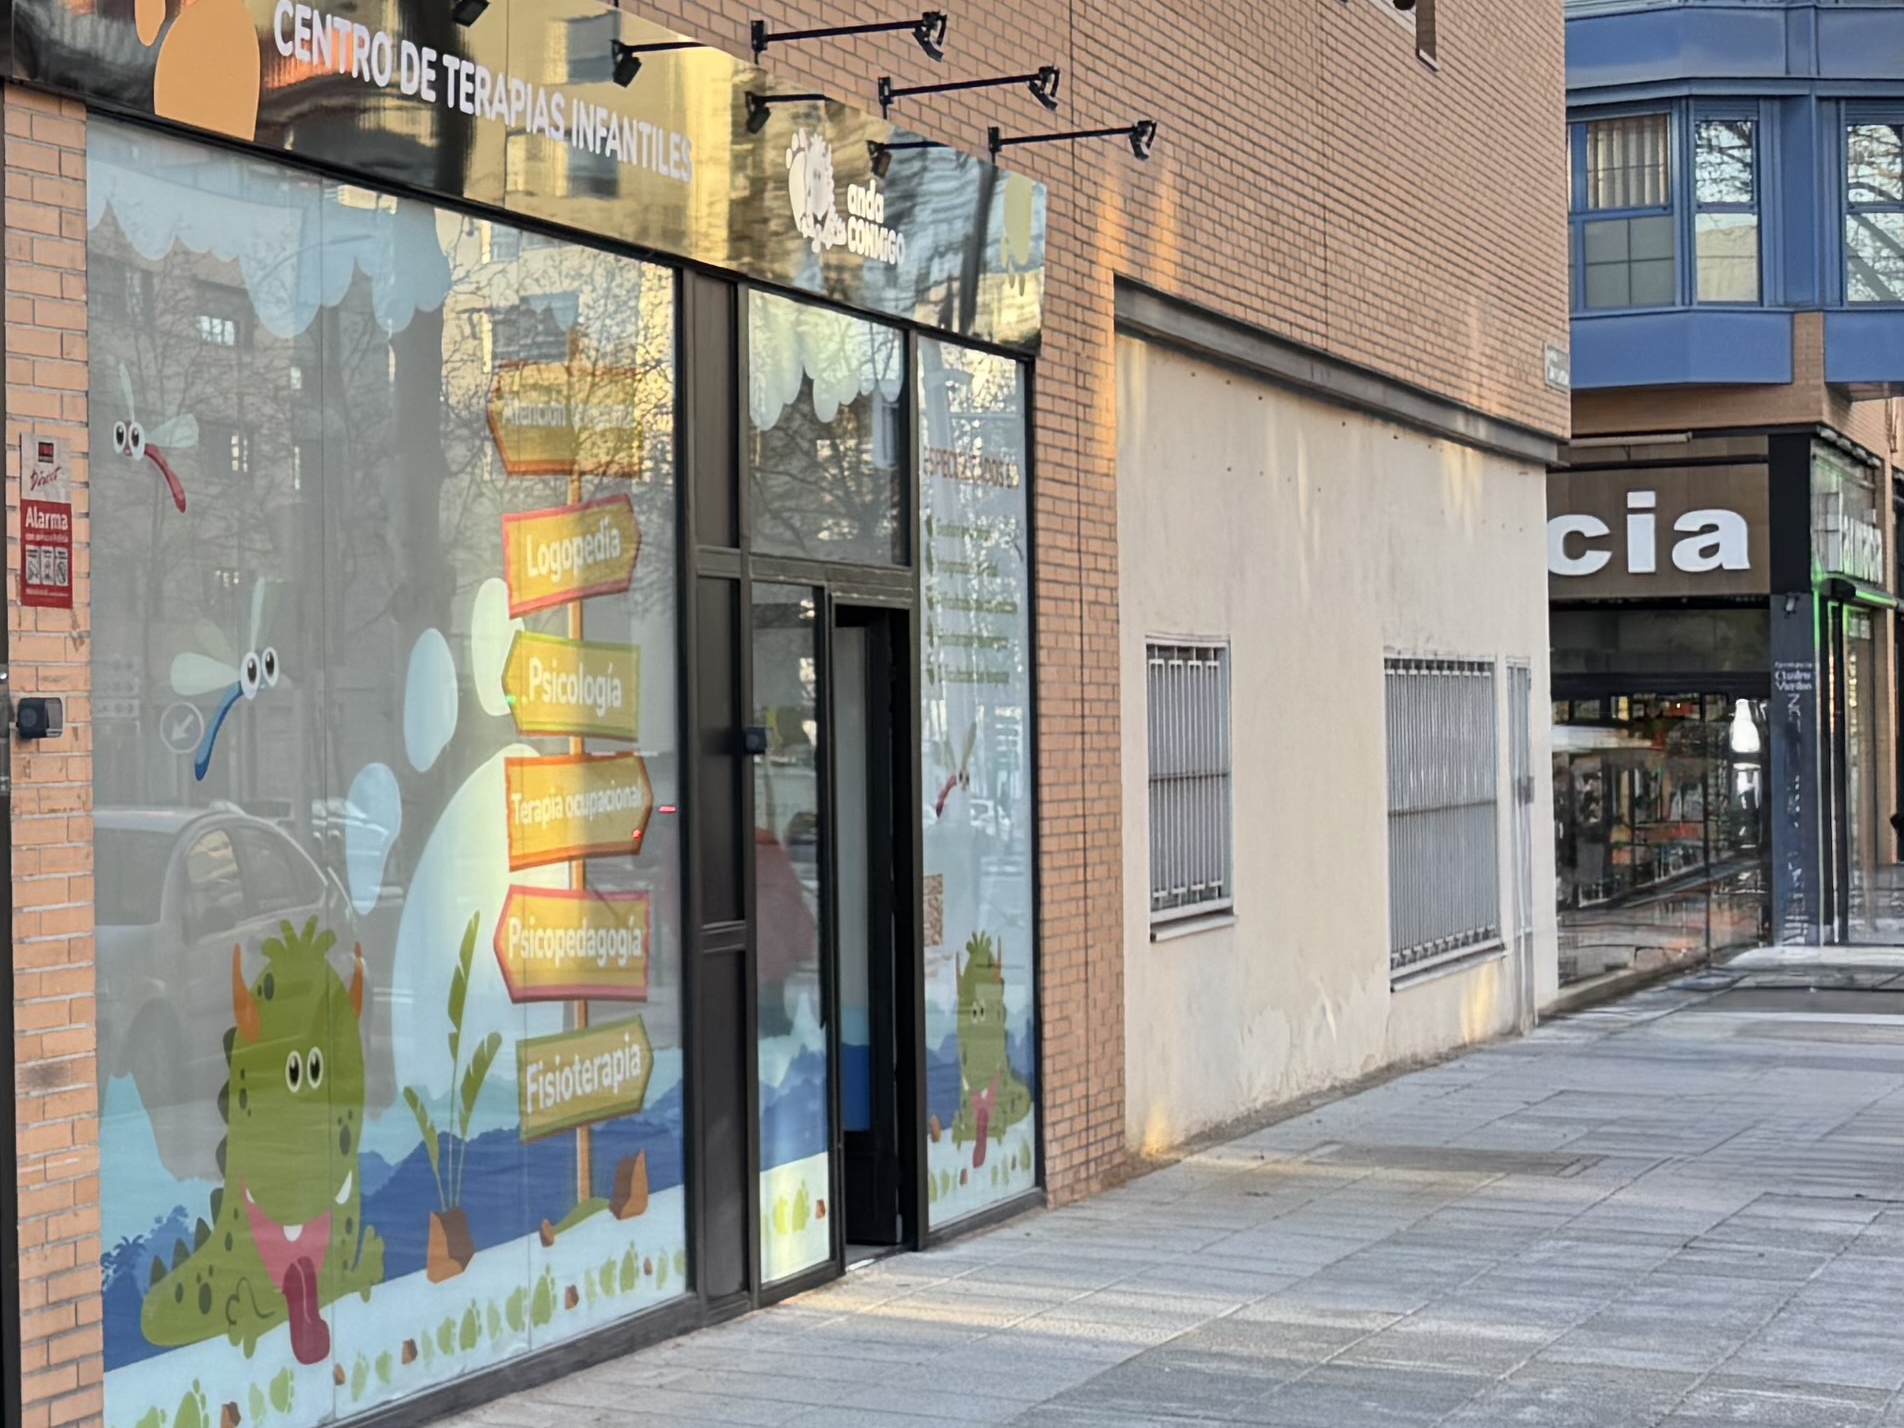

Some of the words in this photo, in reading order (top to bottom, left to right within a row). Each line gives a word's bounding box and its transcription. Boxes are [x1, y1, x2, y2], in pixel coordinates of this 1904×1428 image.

[400, 40, 437, 103] DE
[442, 54, 566, 141] TERAPIAS
[572, 99, 692, 182] INFANTILES
[847, 179, 884, 223] anda
[25, 506, 68, 530] Alarma
[1547, 491, 1751, 576] cia
[529, 656, 622, 716] Psicología
[511, 788, 563, 830] Terapia
[565, 779, 642, 822] ocupacional
[508, 916, 643, 969] Psicopedagogía
[525, 1032, 641, 1115] Fisioterapia
